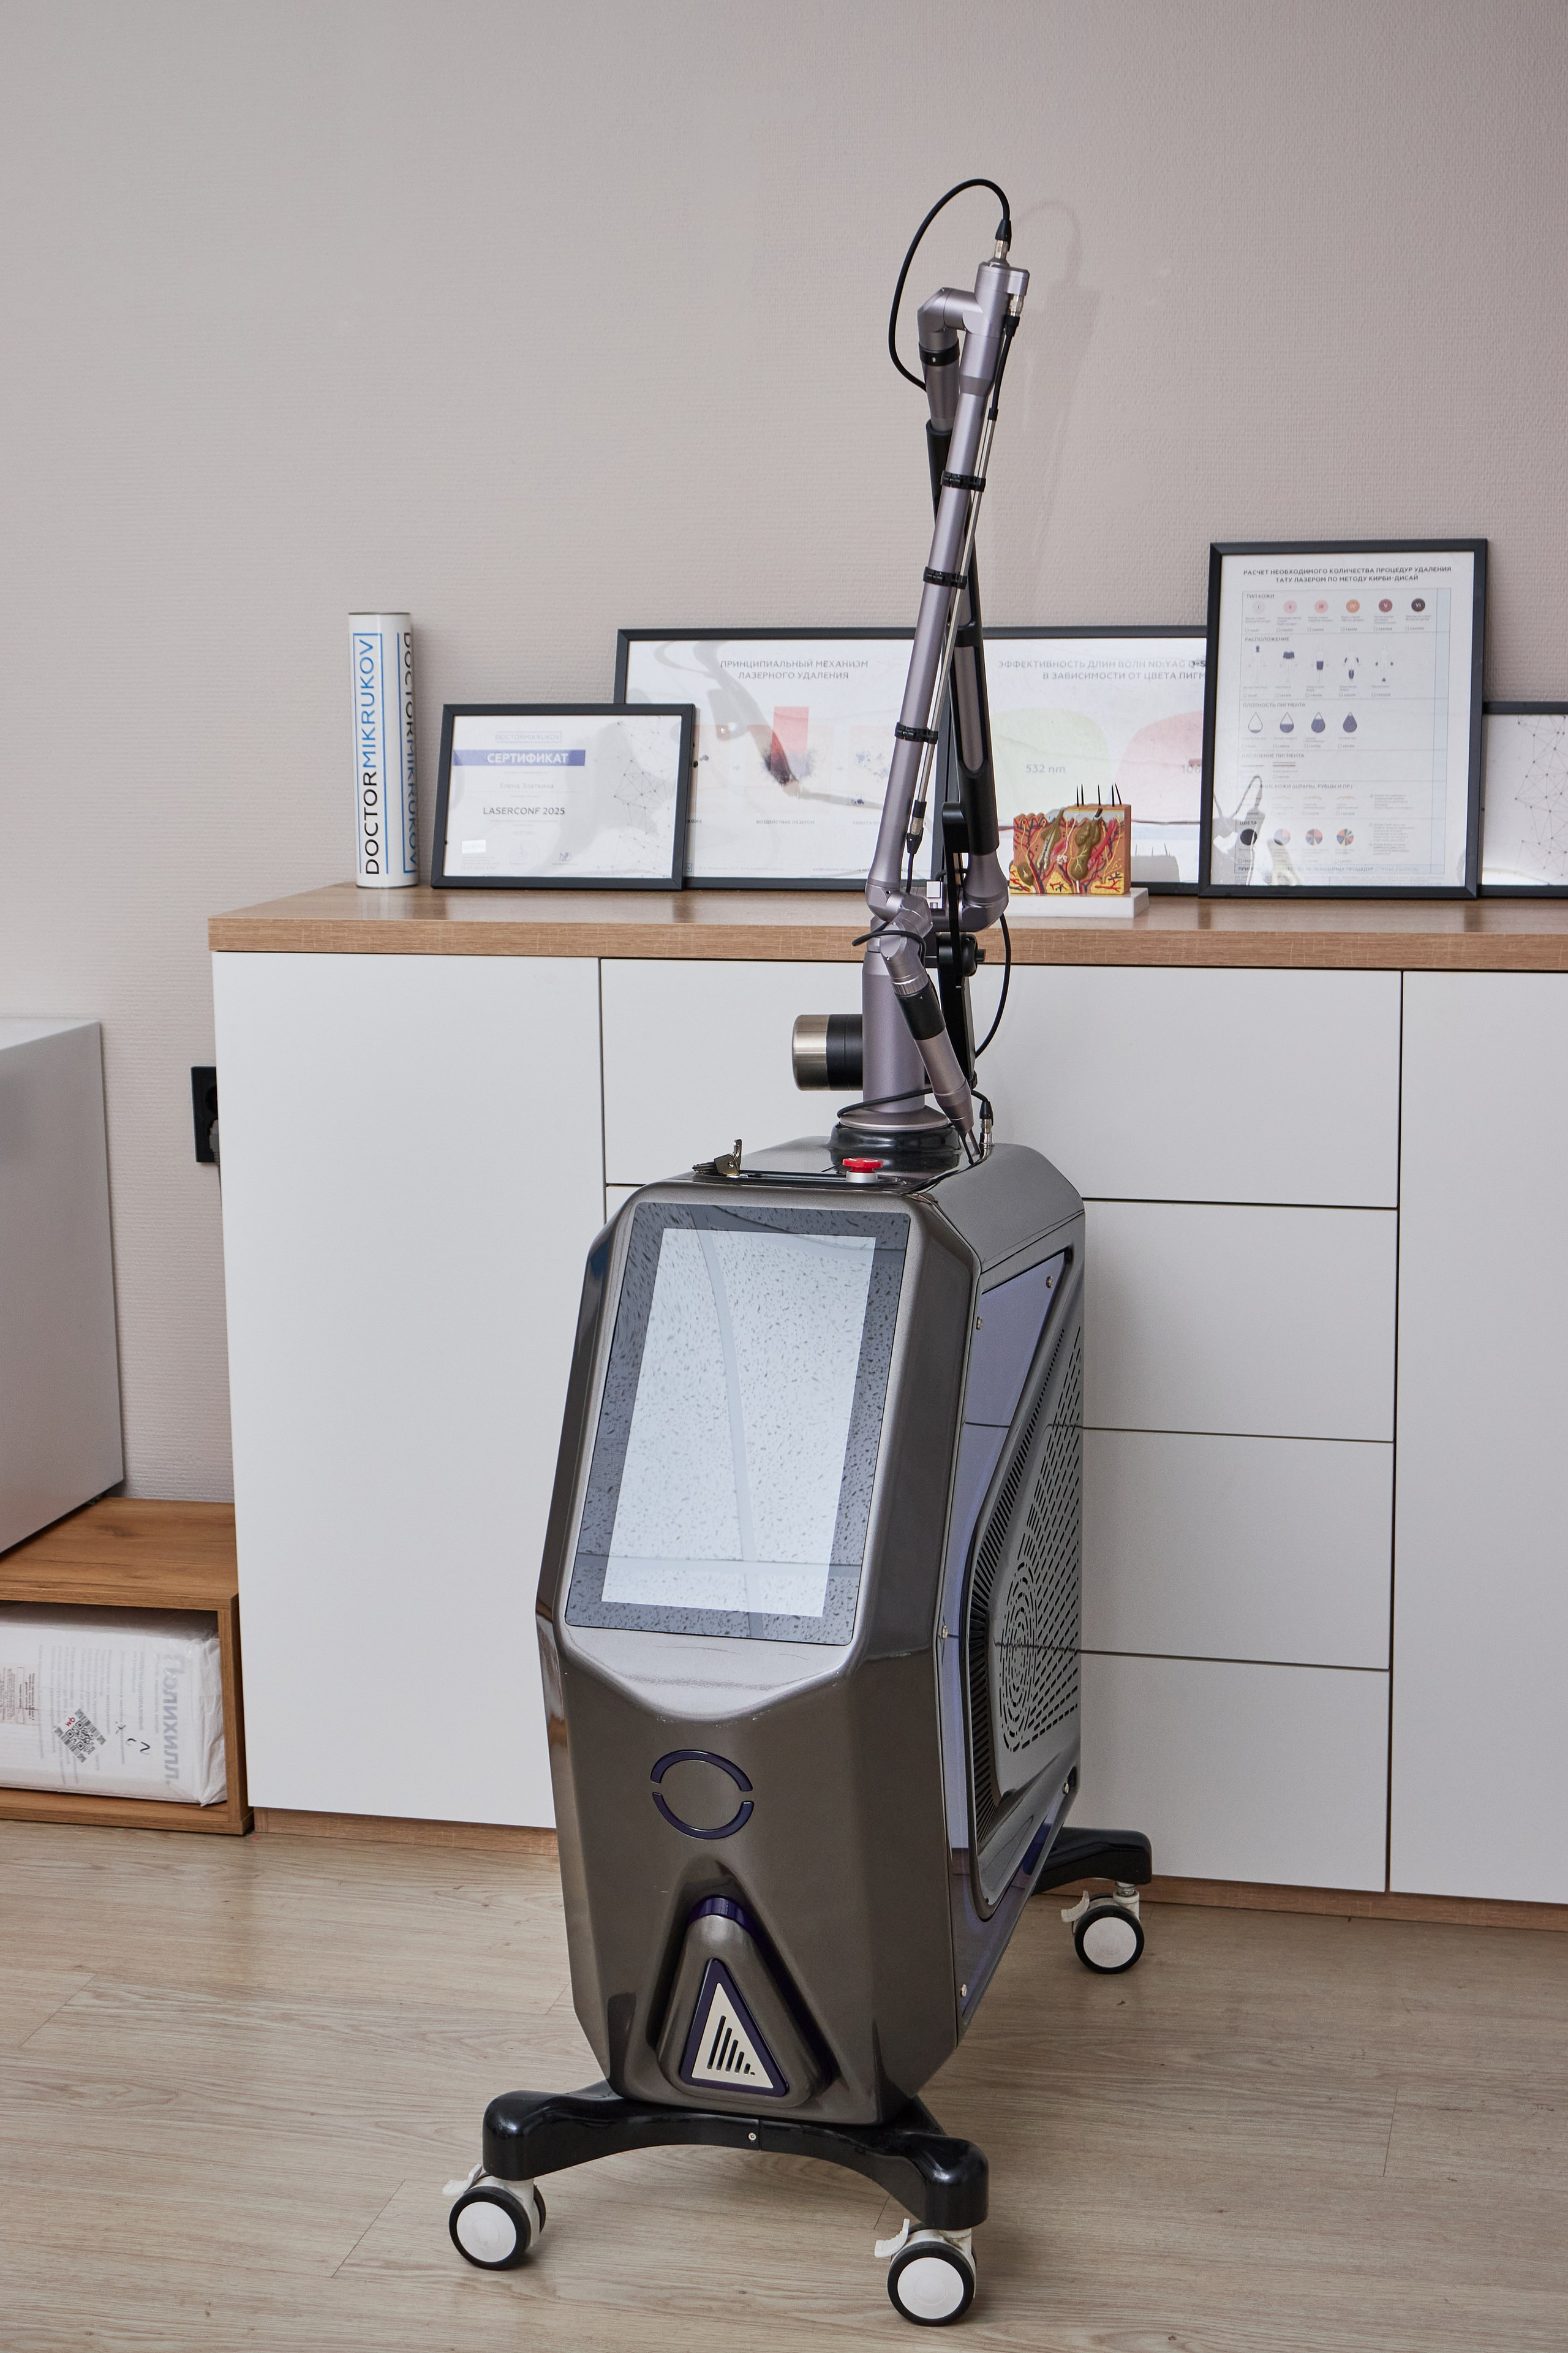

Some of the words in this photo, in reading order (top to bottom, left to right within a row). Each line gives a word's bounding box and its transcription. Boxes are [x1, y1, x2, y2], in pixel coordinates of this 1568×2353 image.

[1368, 573, 1419, 582] КИРБИ-ДИСАЙ
[720, 659, 813, 668] ПРИНЦИПИАЛЬНЫЙ
[1087, 660, 1115, 670] ДЛИН
[1118, 660, 1146, 668] ВОЛН
[1148, 660, 1186, 668] ND:YAG
[797, 671, 849, 680] УДАЛЕНИЯ
[1144, 672, 1177, 681] ЦВЕТА
[358, 639, 380, 875] DOCTORMIKRUKOV
[486, 753, 568, 764] СЕРТИФИКАТ
[1025, 764, 1045, 773] 532
[483, 807, 540, 815] LASERCONF
[542, 807, 565, 815] 2025
